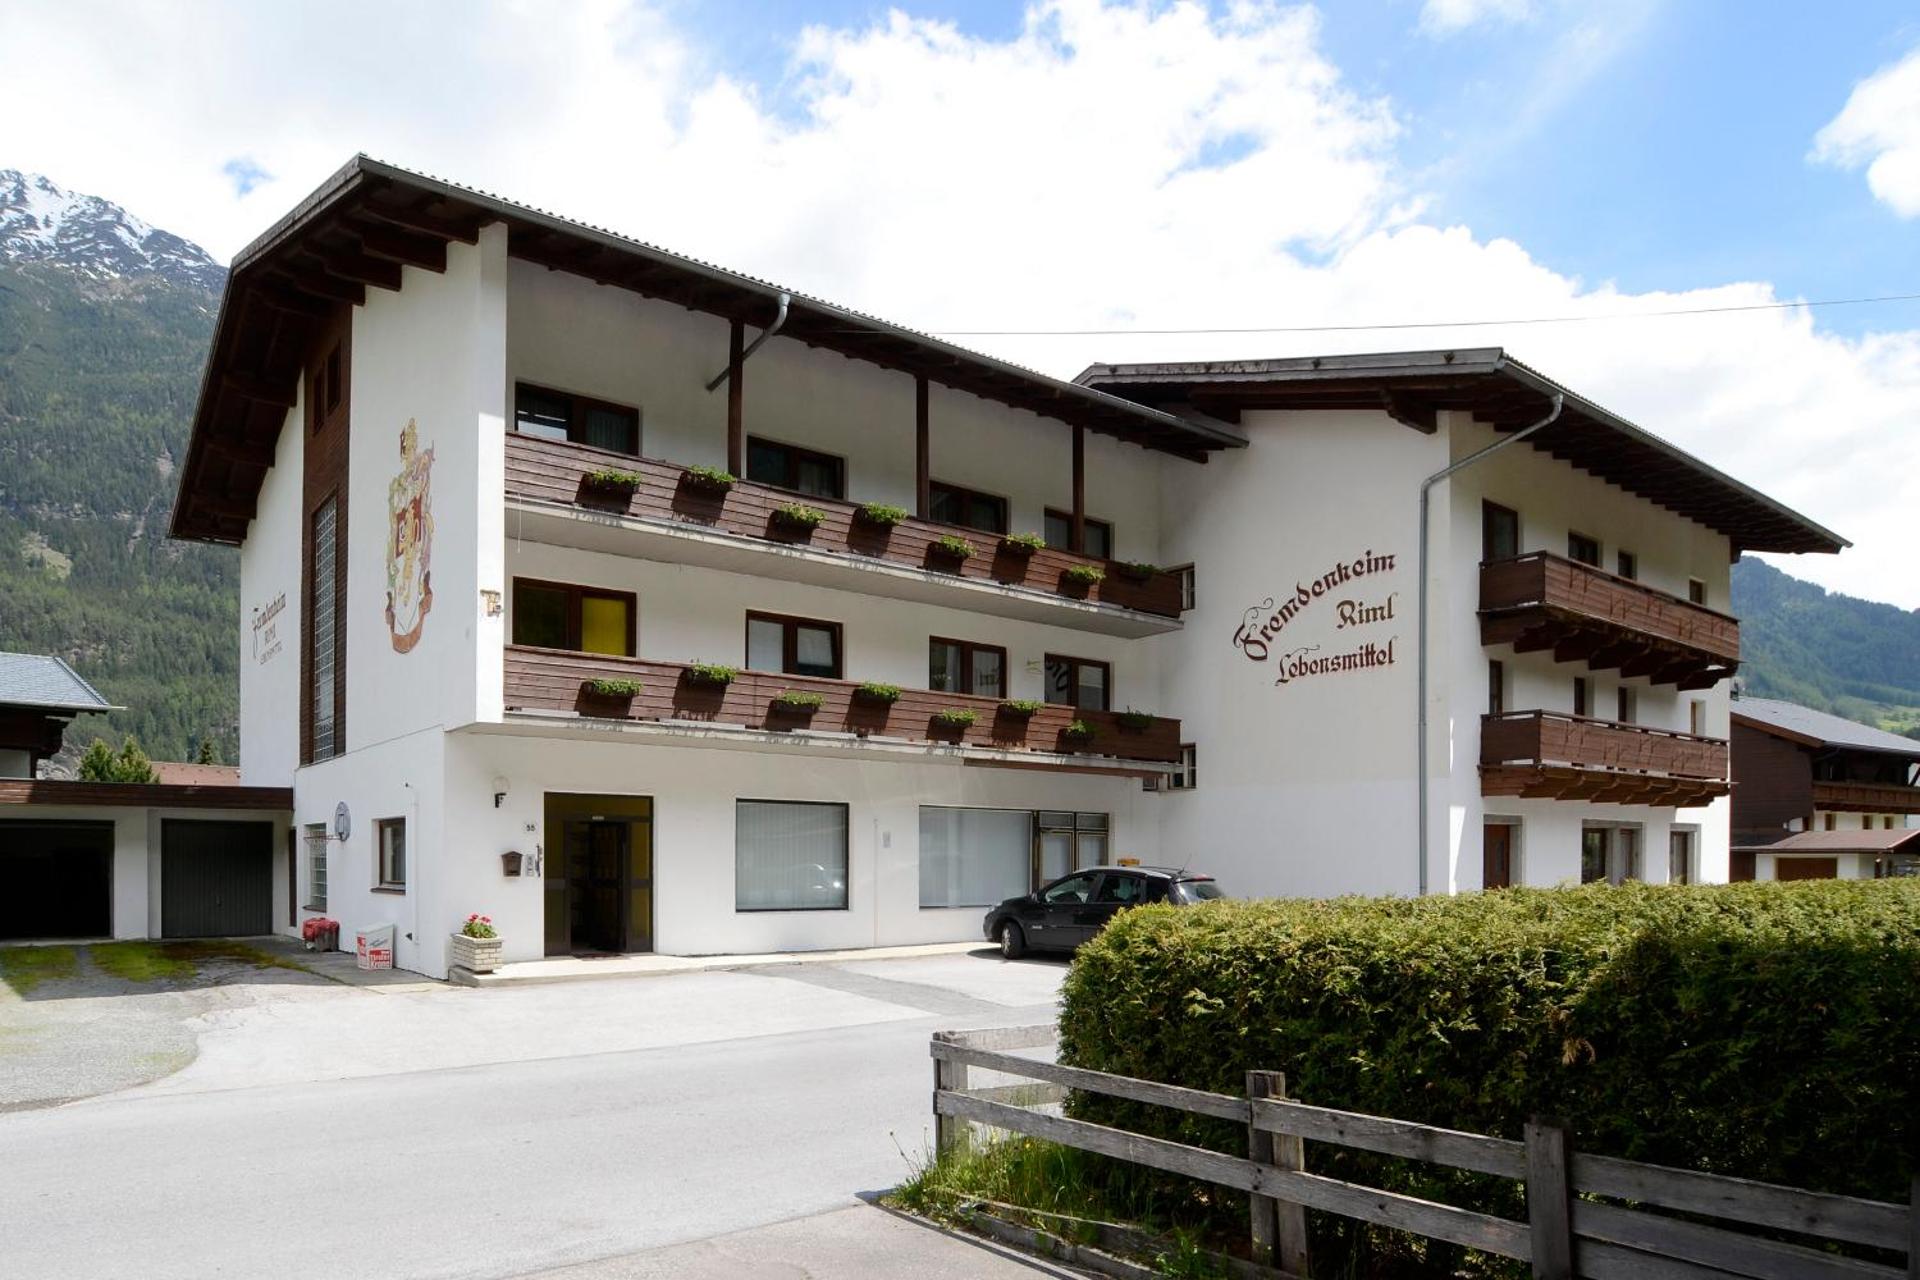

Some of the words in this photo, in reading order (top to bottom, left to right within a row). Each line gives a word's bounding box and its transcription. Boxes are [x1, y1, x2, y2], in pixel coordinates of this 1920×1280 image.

[1233, 549, 1396, 662] Fremdenheim
[1336, 592, 1398, 630] Riml
[1274, 636, 1398, 687] Lebensmittel
